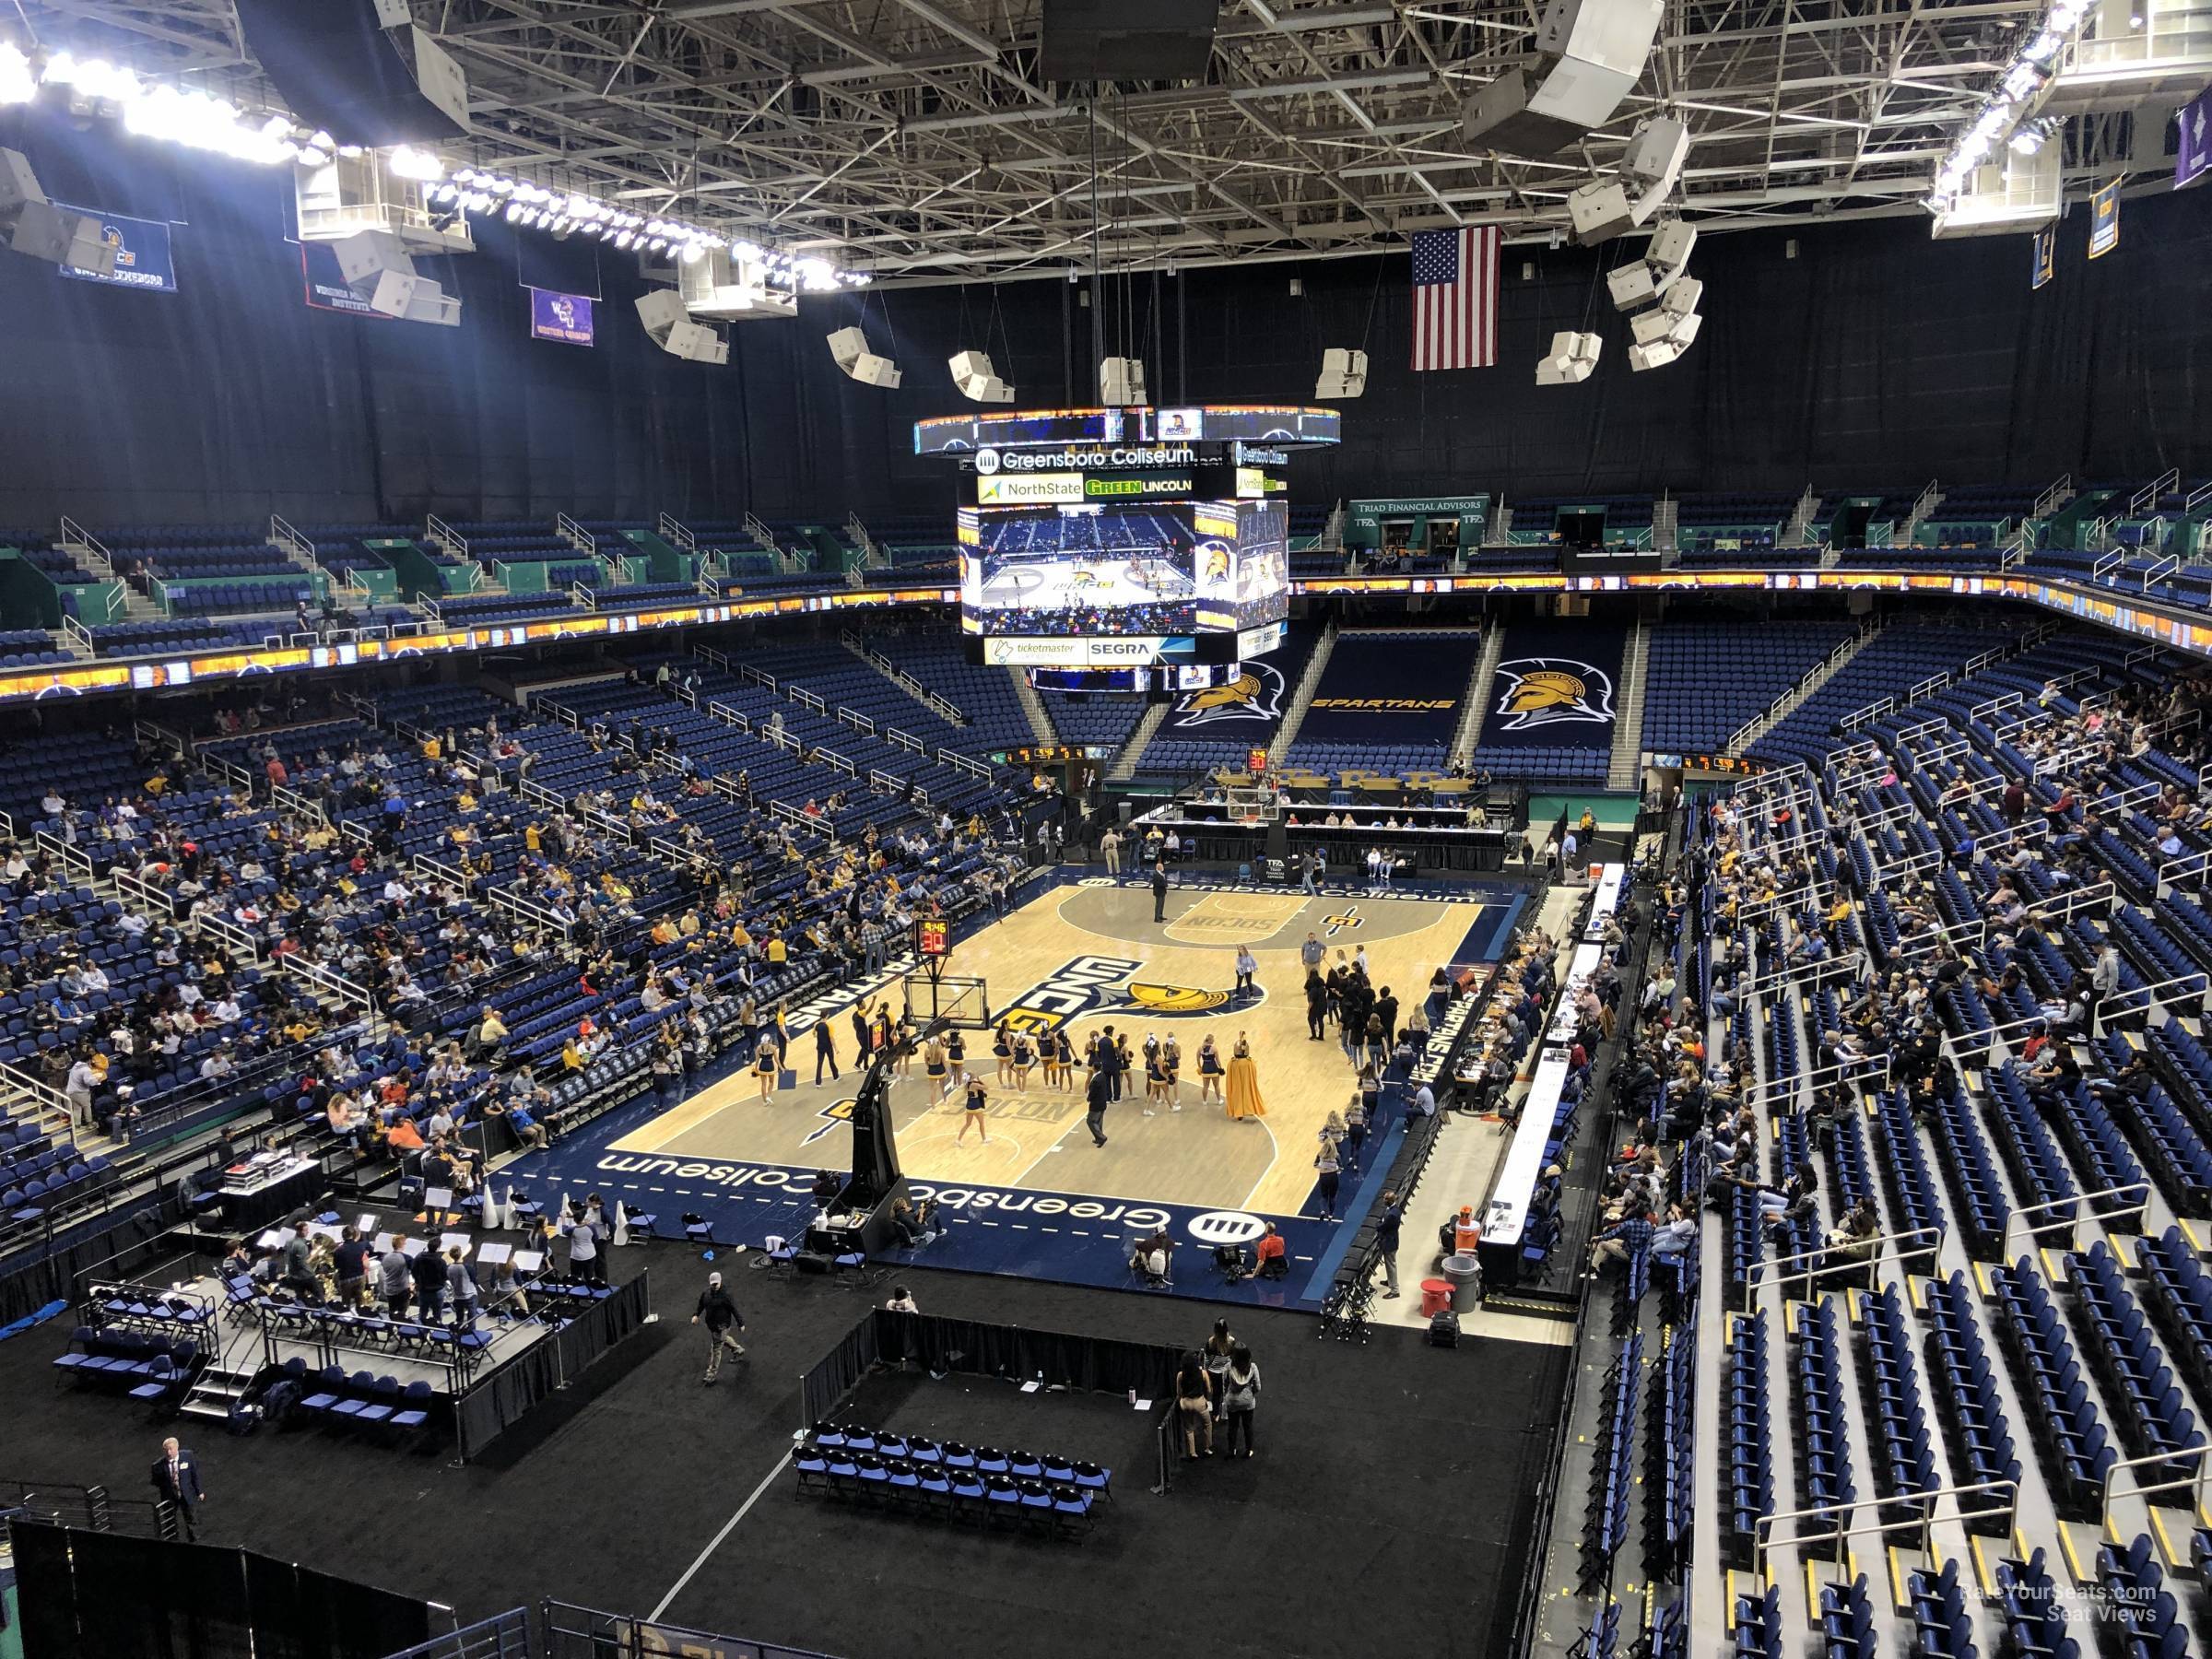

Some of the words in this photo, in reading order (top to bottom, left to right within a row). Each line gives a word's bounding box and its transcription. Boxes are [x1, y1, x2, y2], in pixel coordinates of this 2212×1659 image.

[1003, 451, 1105, 468] Greensboro
[1112, 448, 1194, 465] Coliseum
[1008, 478, 1081, 495] NorthState
[1086, 479, 1142, 496] GREEN
[1143, 480, 1192, 492] LINCOLN
[1354, 518, 1378, 527] TFA
[1463, 514, 1485, 524] TFA
[1018, 644, 1075, 653] ticketmaster
[1091, 644, 1149, 654] SEGRA
[1311, 699, 1456, 709] SPARTANS
[1251, 757, 1265, 769] 30
[1266, 859, 1286, 867] TFA
[1125, 880, 1308, 896] Geensboro
[1321, 889, 1476, 903] Coliseum
[925, 922, 947, 933] 9:46
[923, 933, 945, 952] 30
[992, 956, 1134, 1033] UNCG
